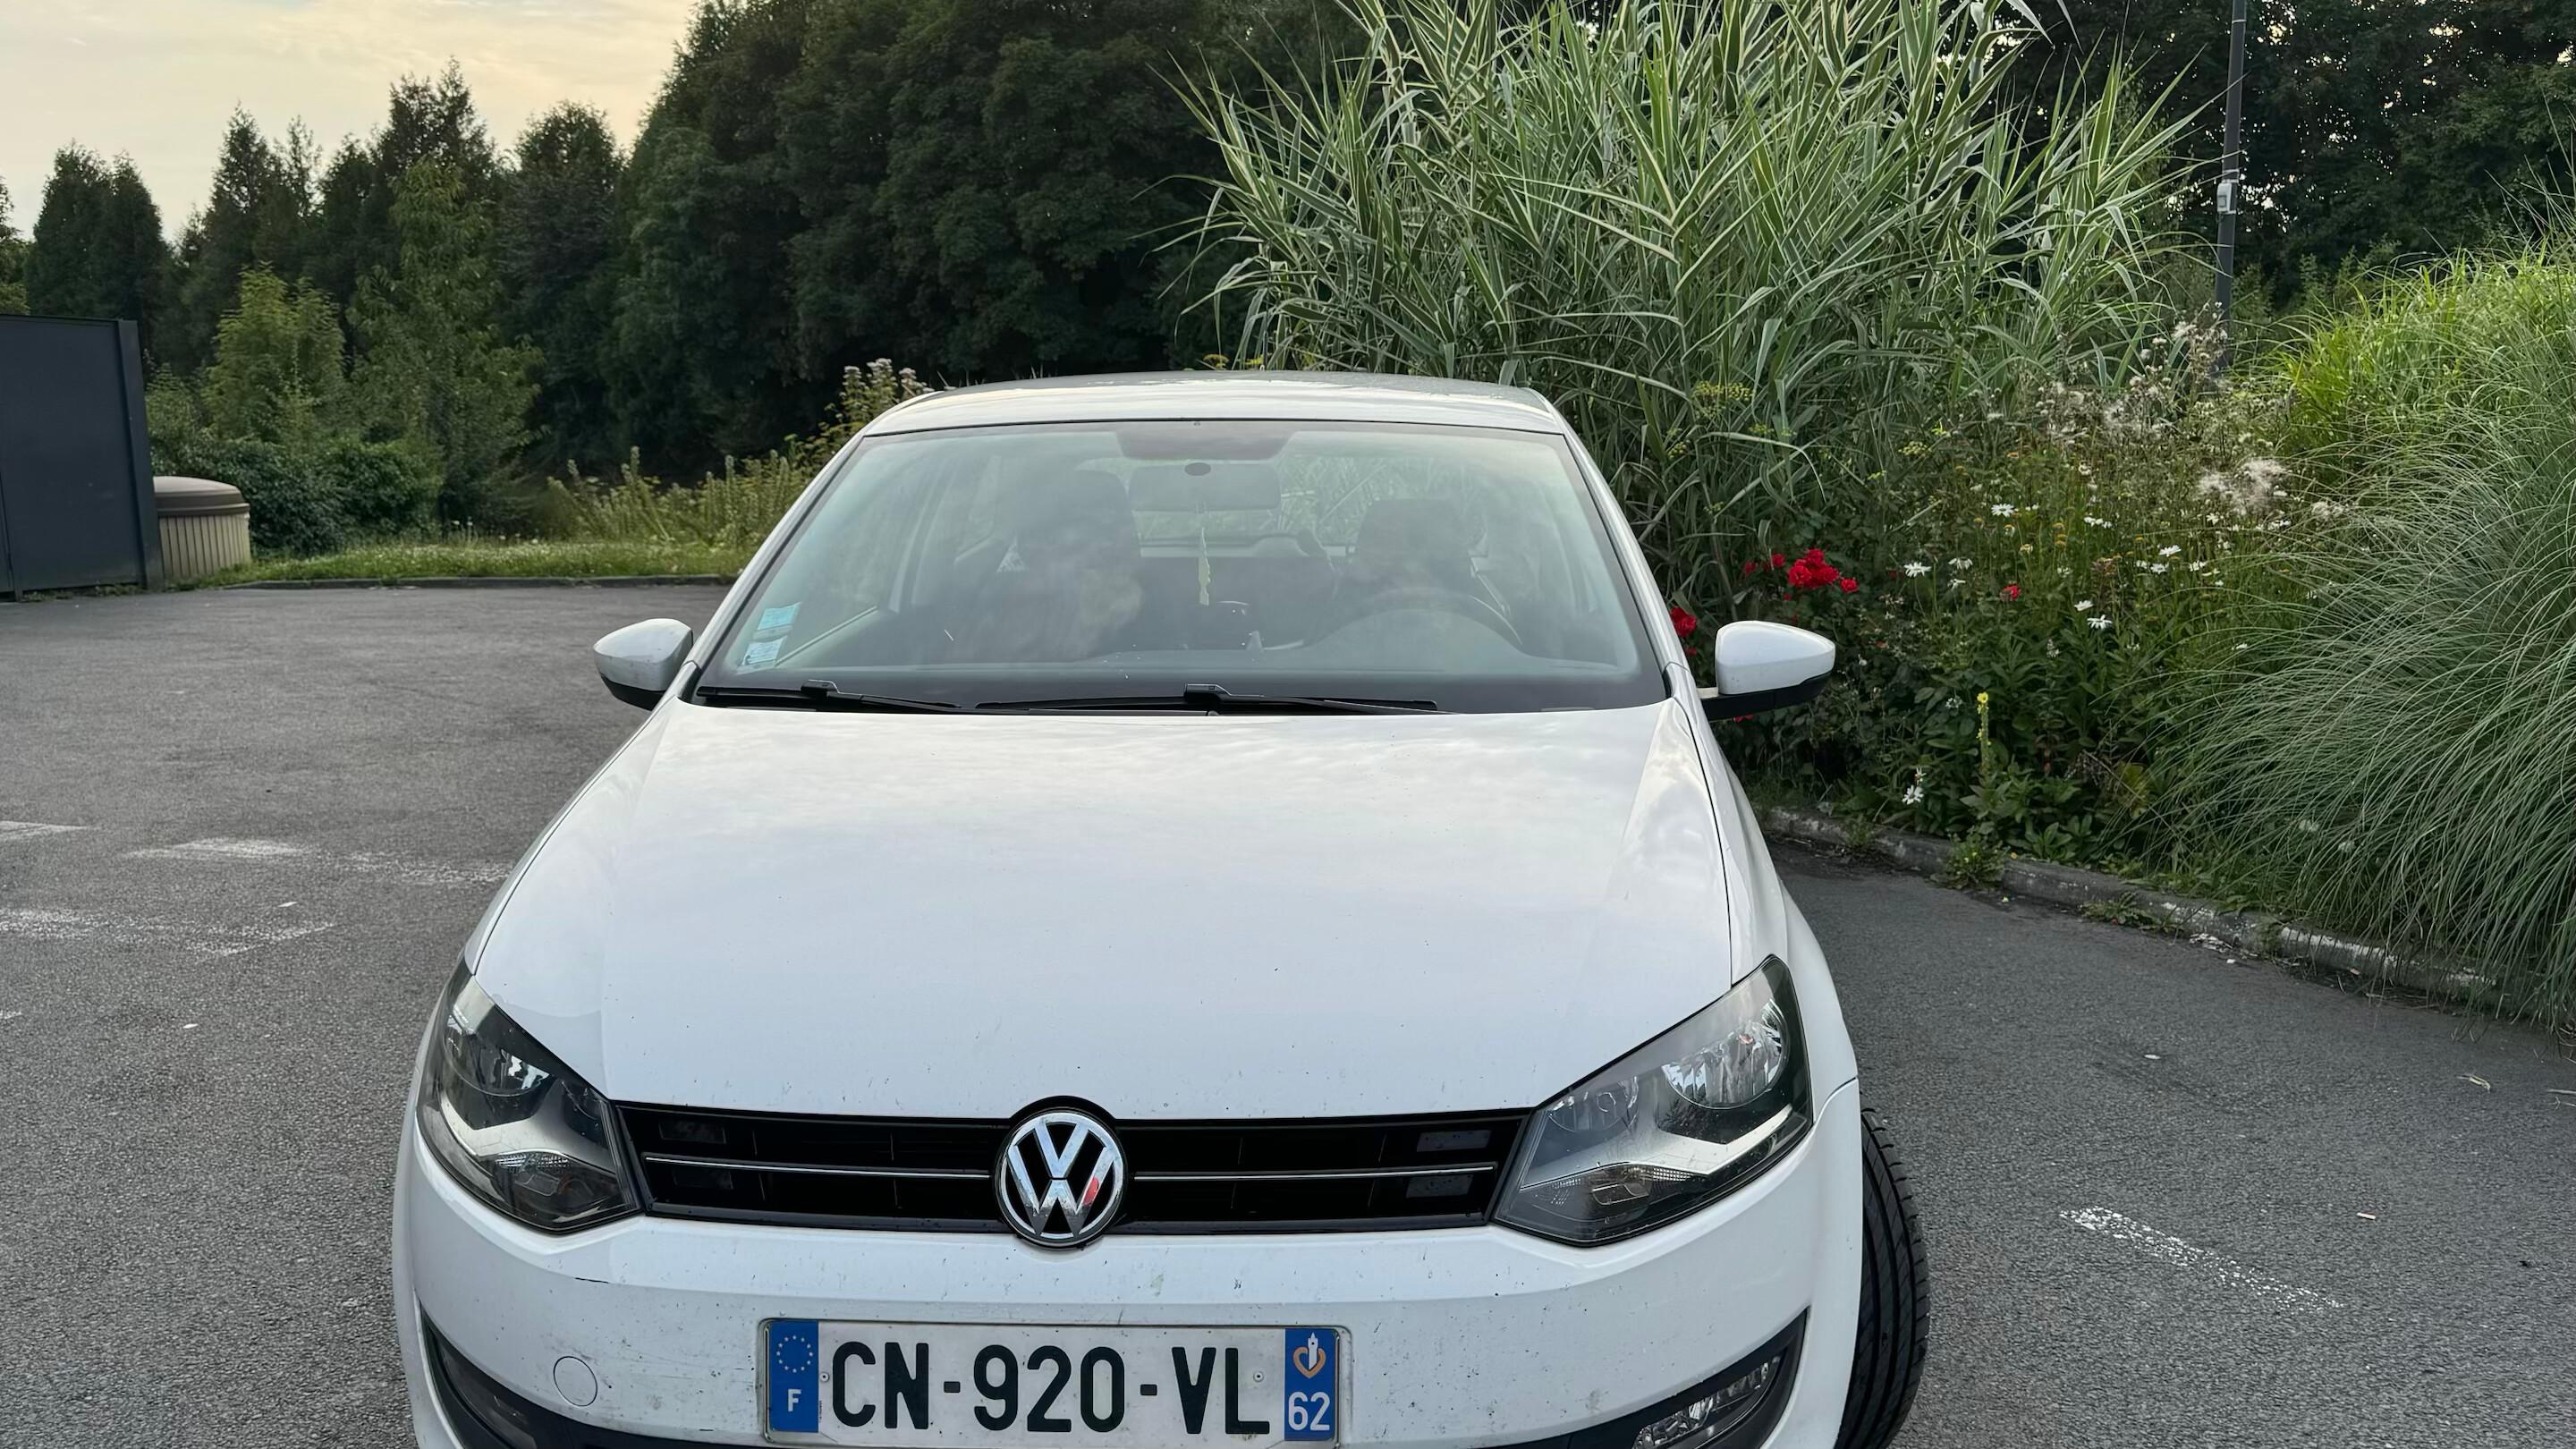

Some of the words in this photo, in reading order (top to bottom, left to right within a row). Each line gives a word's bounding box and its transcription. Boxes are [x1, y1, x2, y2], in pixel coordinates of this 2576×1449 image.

[1005, 1118, 1120, 1237] VW
[787, 1388, 801, 1412] F
[832, 1341, 1270, 1435] CN-920-VL
[1288, 1391, 1331, 1431] 62
